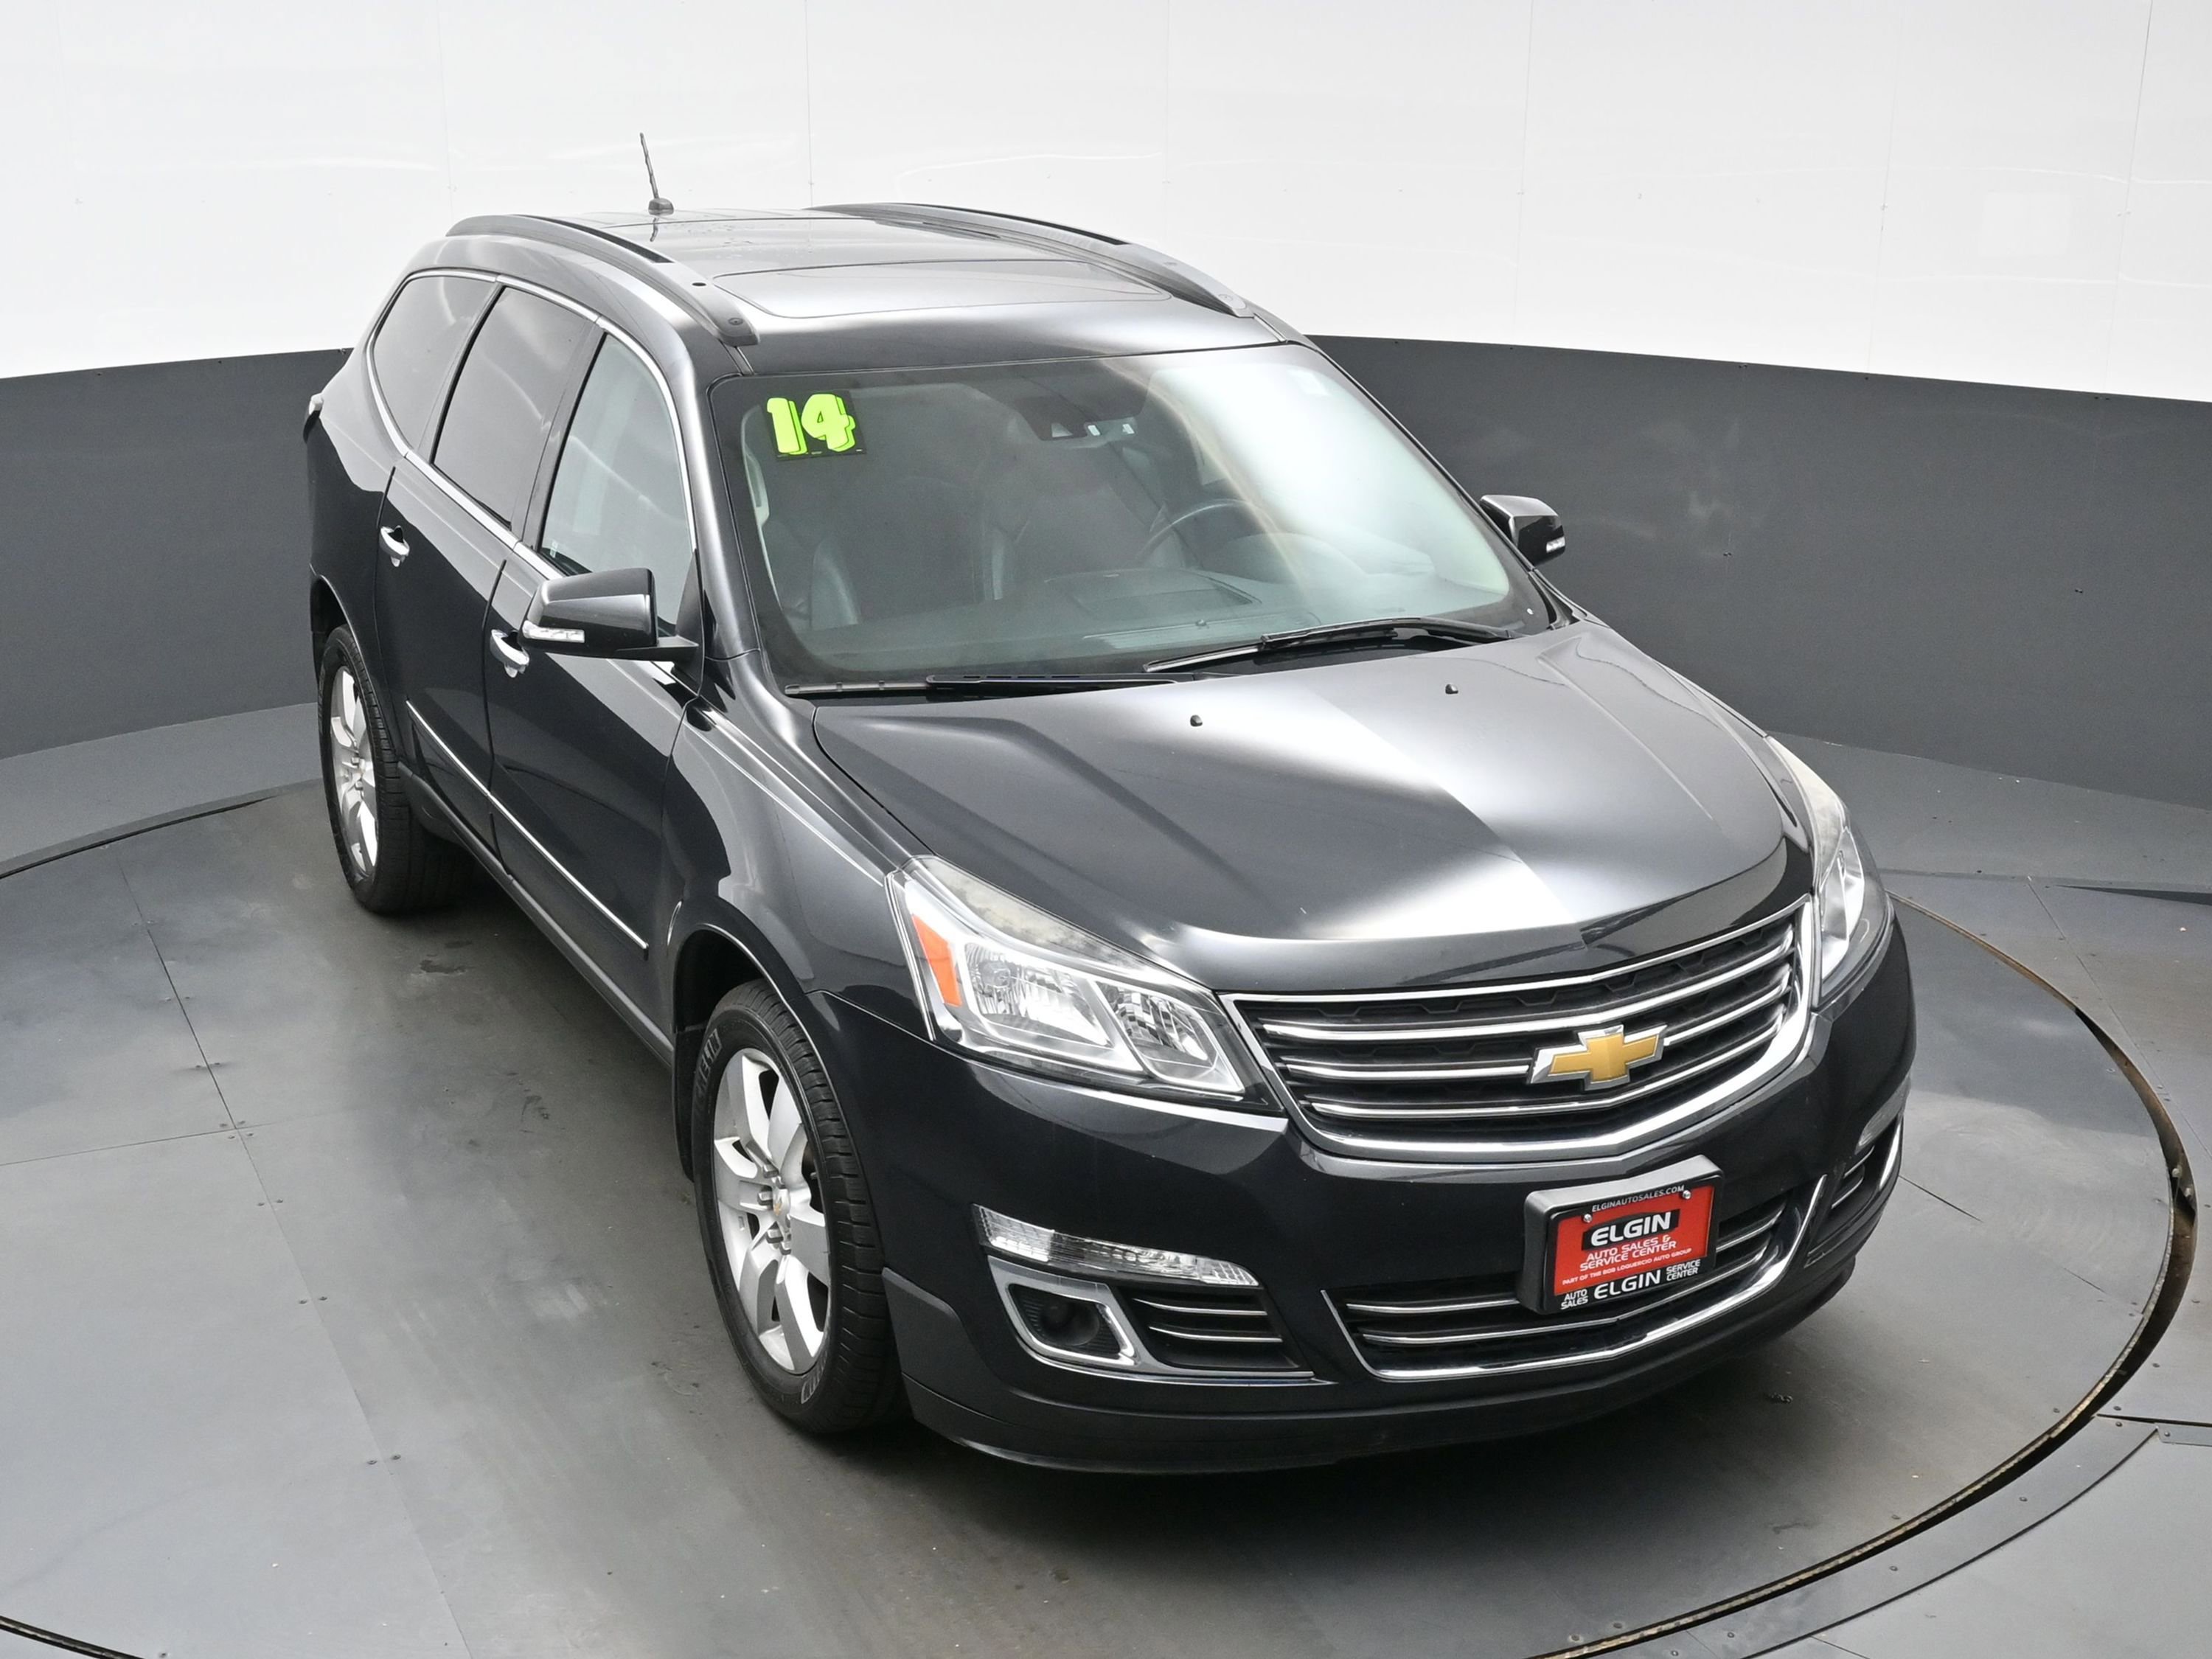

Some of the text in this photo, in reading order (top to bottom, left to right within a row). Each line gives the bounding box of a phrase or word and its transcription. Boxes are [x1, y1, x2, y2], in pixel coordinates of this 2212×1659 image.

[767, 394, 855, 455] 14
[1591, 1184, 1684, 1212] ELGINAUTOSALES.COM
[1590, 1211, 1672, 1247] ELGIN
[1579, 1240, 1677, 1272] SERVICE CENTER
[1586, 1234, 1671, 1262] AUTO SALES &
[1562, 1276, 1579, 1285] PART
[1653, 1253, 1670, 1262] AUTO
[1671, 1248, 1692, 1257] GROUP
[1666, 1259, 1701, 1275] SERVICE
[1666, 1267, 1699, 1281] CENTER
[1564, 1288, 1587, 1301] AUTO
[1593, 1269, 1661, 1299] ELGIN
[1560, 1295, 1589, 1310] SALES
